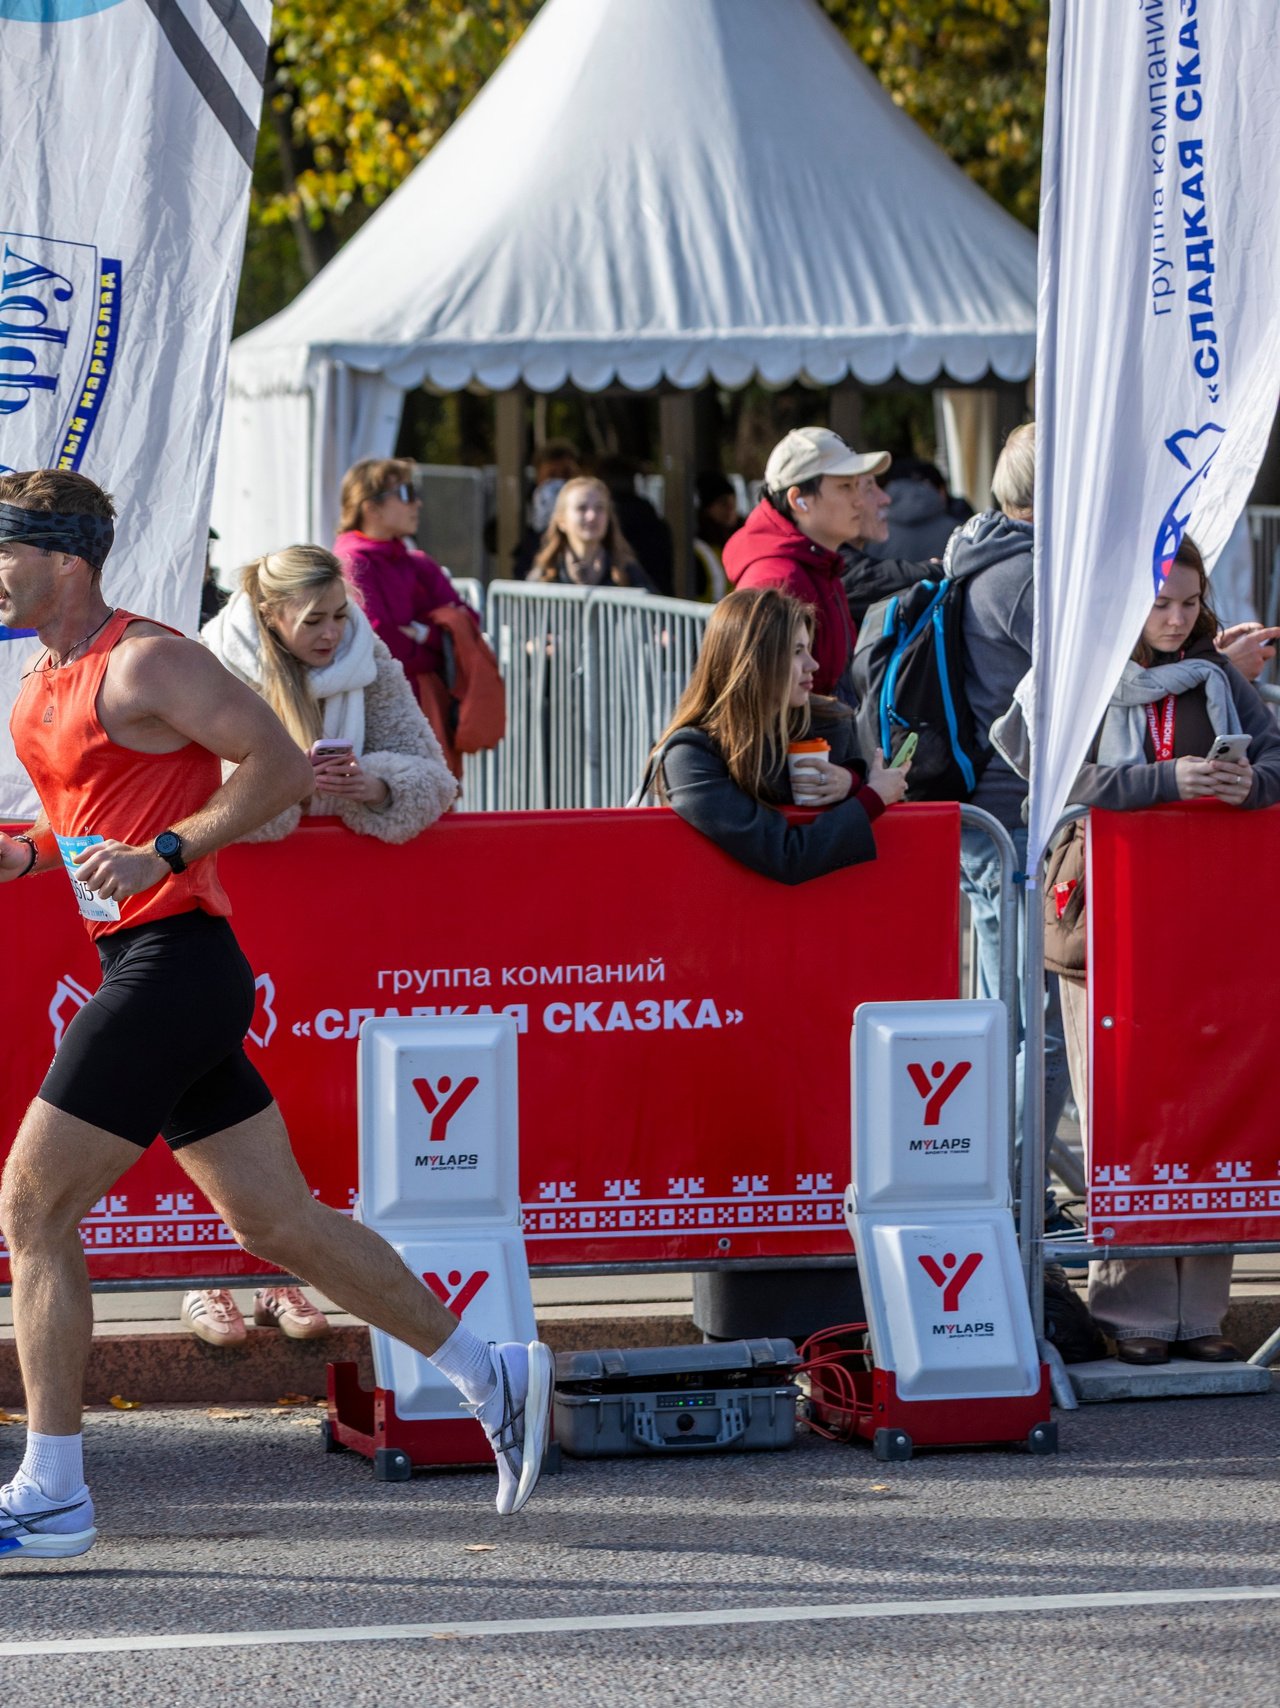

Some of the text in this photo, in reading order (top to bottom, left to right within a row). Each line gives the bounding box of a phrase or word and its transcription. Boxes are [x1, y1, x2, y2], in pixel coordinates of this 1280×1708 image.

[1152, 189, 1176, 316] группа
[1180, 139, 1221, 403] «СЛАДКАЯ
[79, 272, 116, 409] мармелад
[377, 957, 666, 994] группа компаний
[291, 998, 744, 1040] «СЛЯ СКАЗКА»
[415, 1153, 479, 1166] MYLAPS
[909, 1138, 971, 1151] MYLAPS
[932, 1322, 995, 1335] MYLAPS
